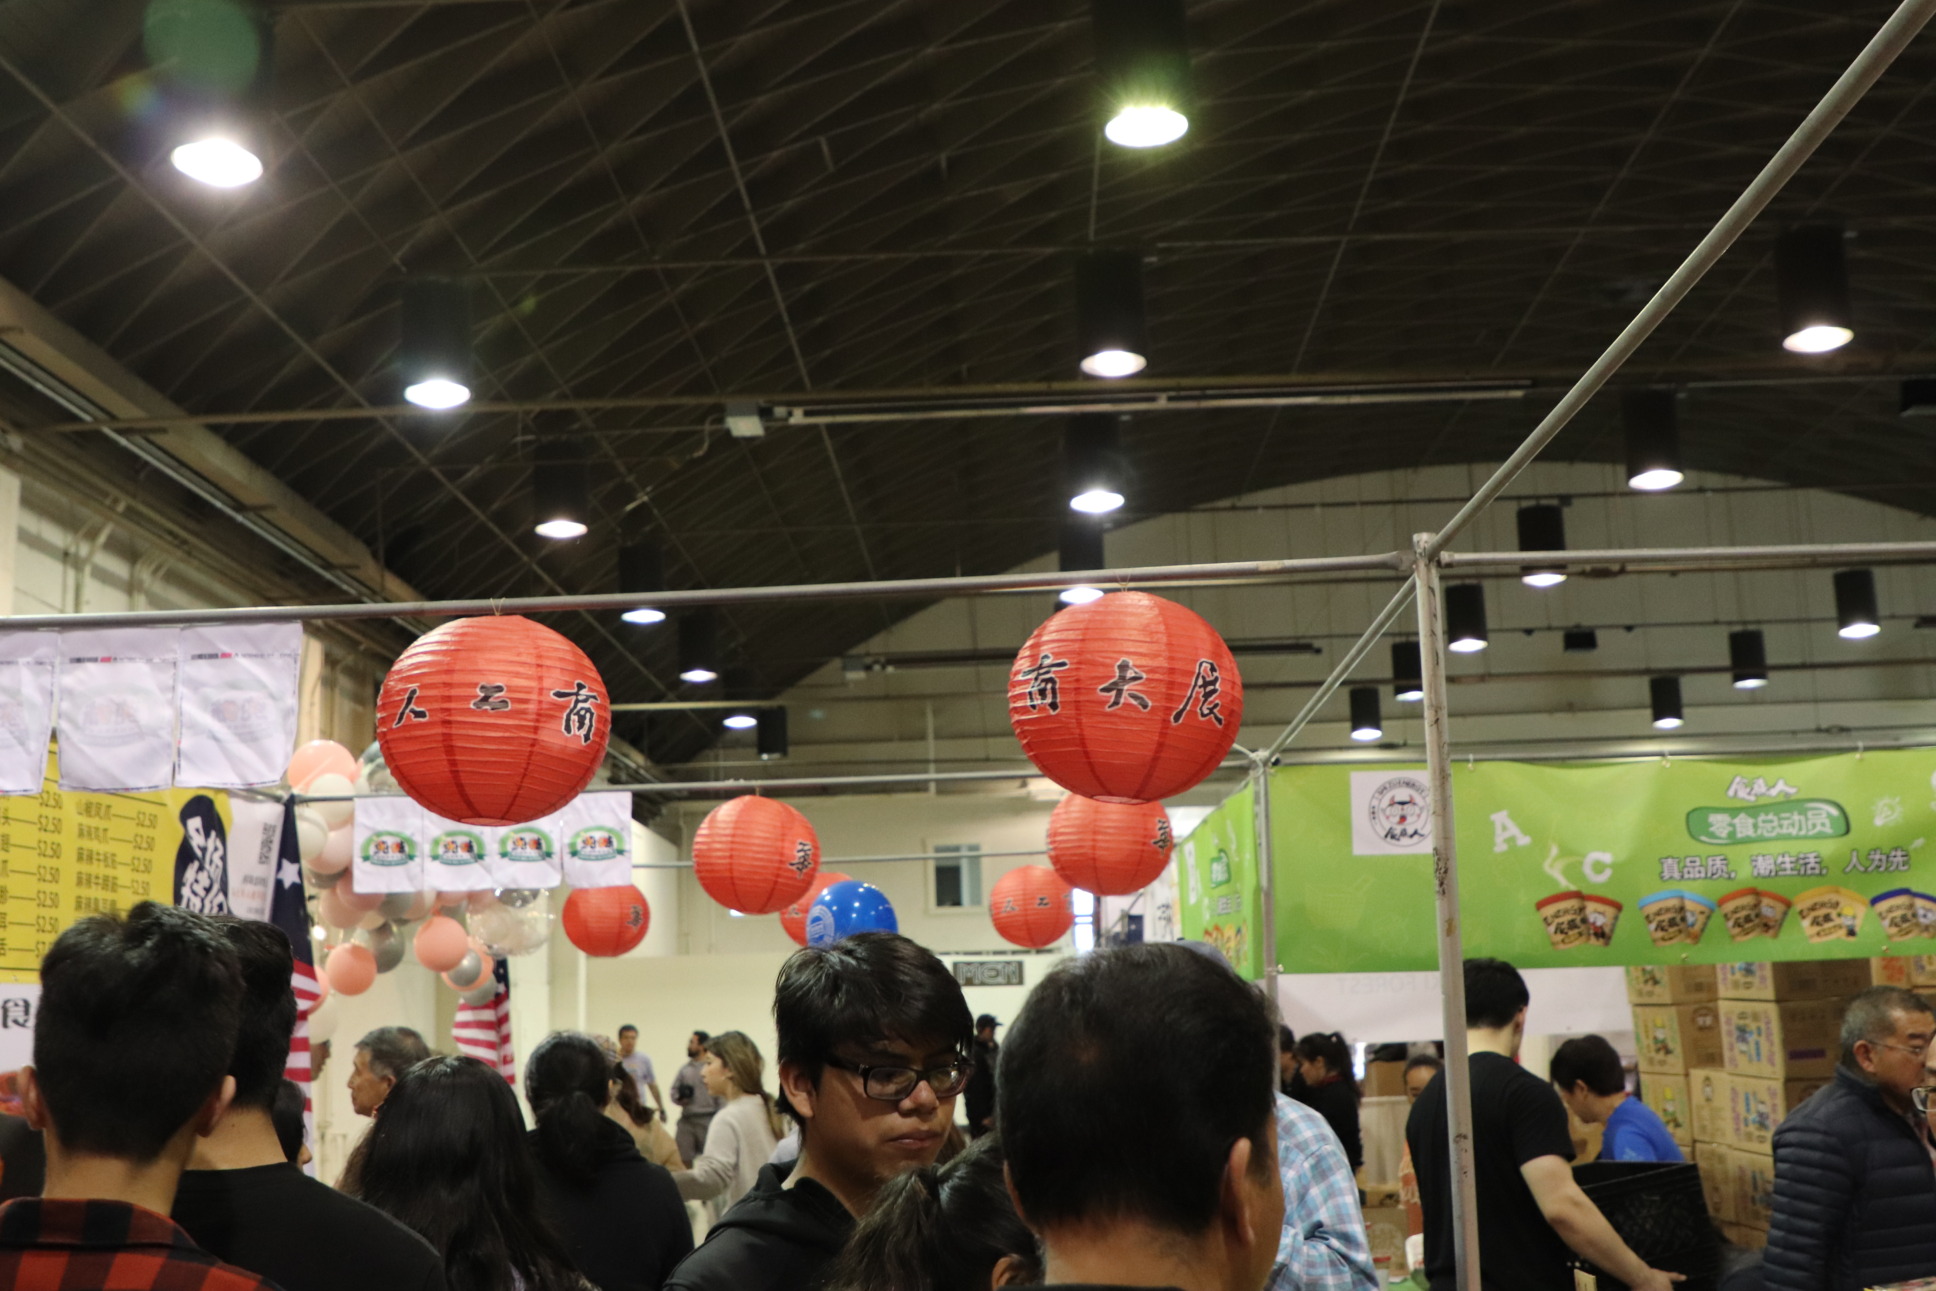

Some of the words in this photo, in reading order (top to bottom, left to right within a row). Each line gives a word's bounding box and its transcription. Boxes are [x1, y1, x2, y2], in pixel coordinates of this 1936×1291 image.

[37, 813, 62, 834] $2.50
[136, 810, 158, 829] $2.50
[1708, 810, 1833, 837] 零食总动员
[37, 839, 62, 859] $2.50
[133, 833, 156, 852] $2.50
[37, 864, 60, 884] $2.50
[130, 856, 153, 875] $2.50
[130, 878, 150, 896] $2.50
[36, 890, 59, 909] $2.50
[36, 914, 59, 934] $2.50
